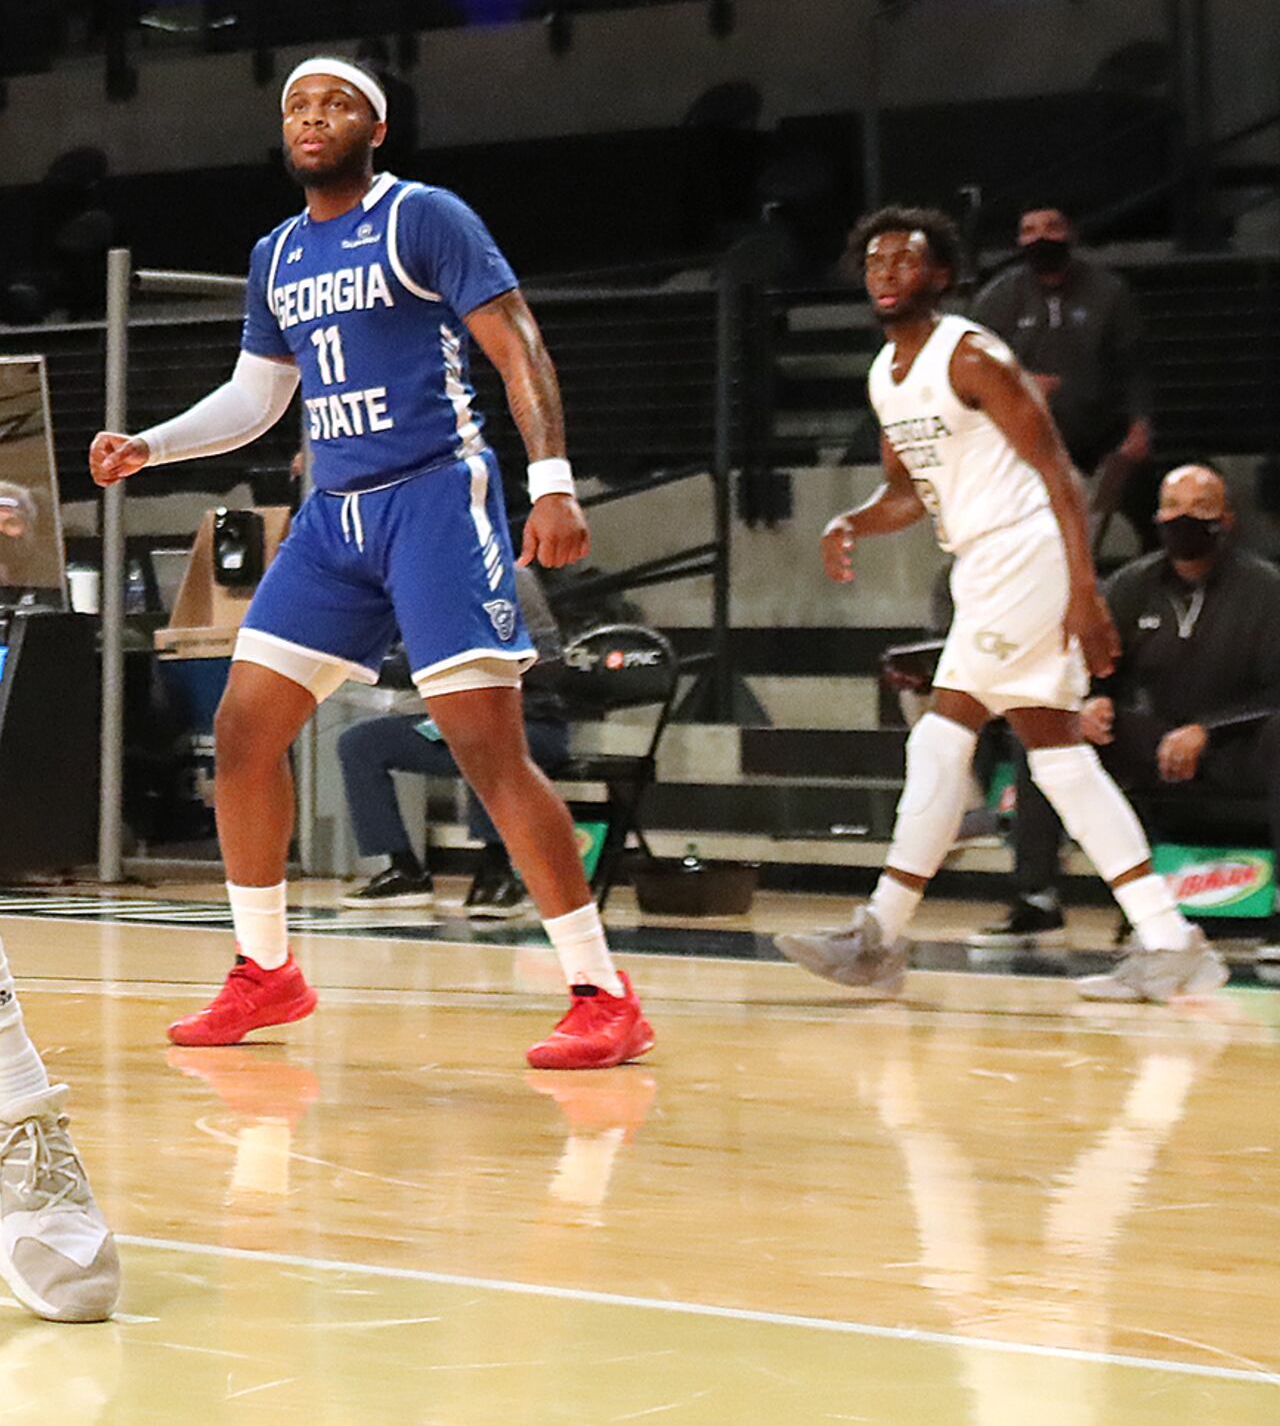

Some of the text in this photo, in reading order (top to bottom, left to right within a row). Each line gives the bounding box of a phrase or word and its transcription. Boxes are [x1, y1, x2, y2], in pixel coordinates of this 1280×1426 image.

[274, 264, 395, 331] GEORGIA
[310, 325, 347, 385] 11
[305, 386, 394, 441] STATE
